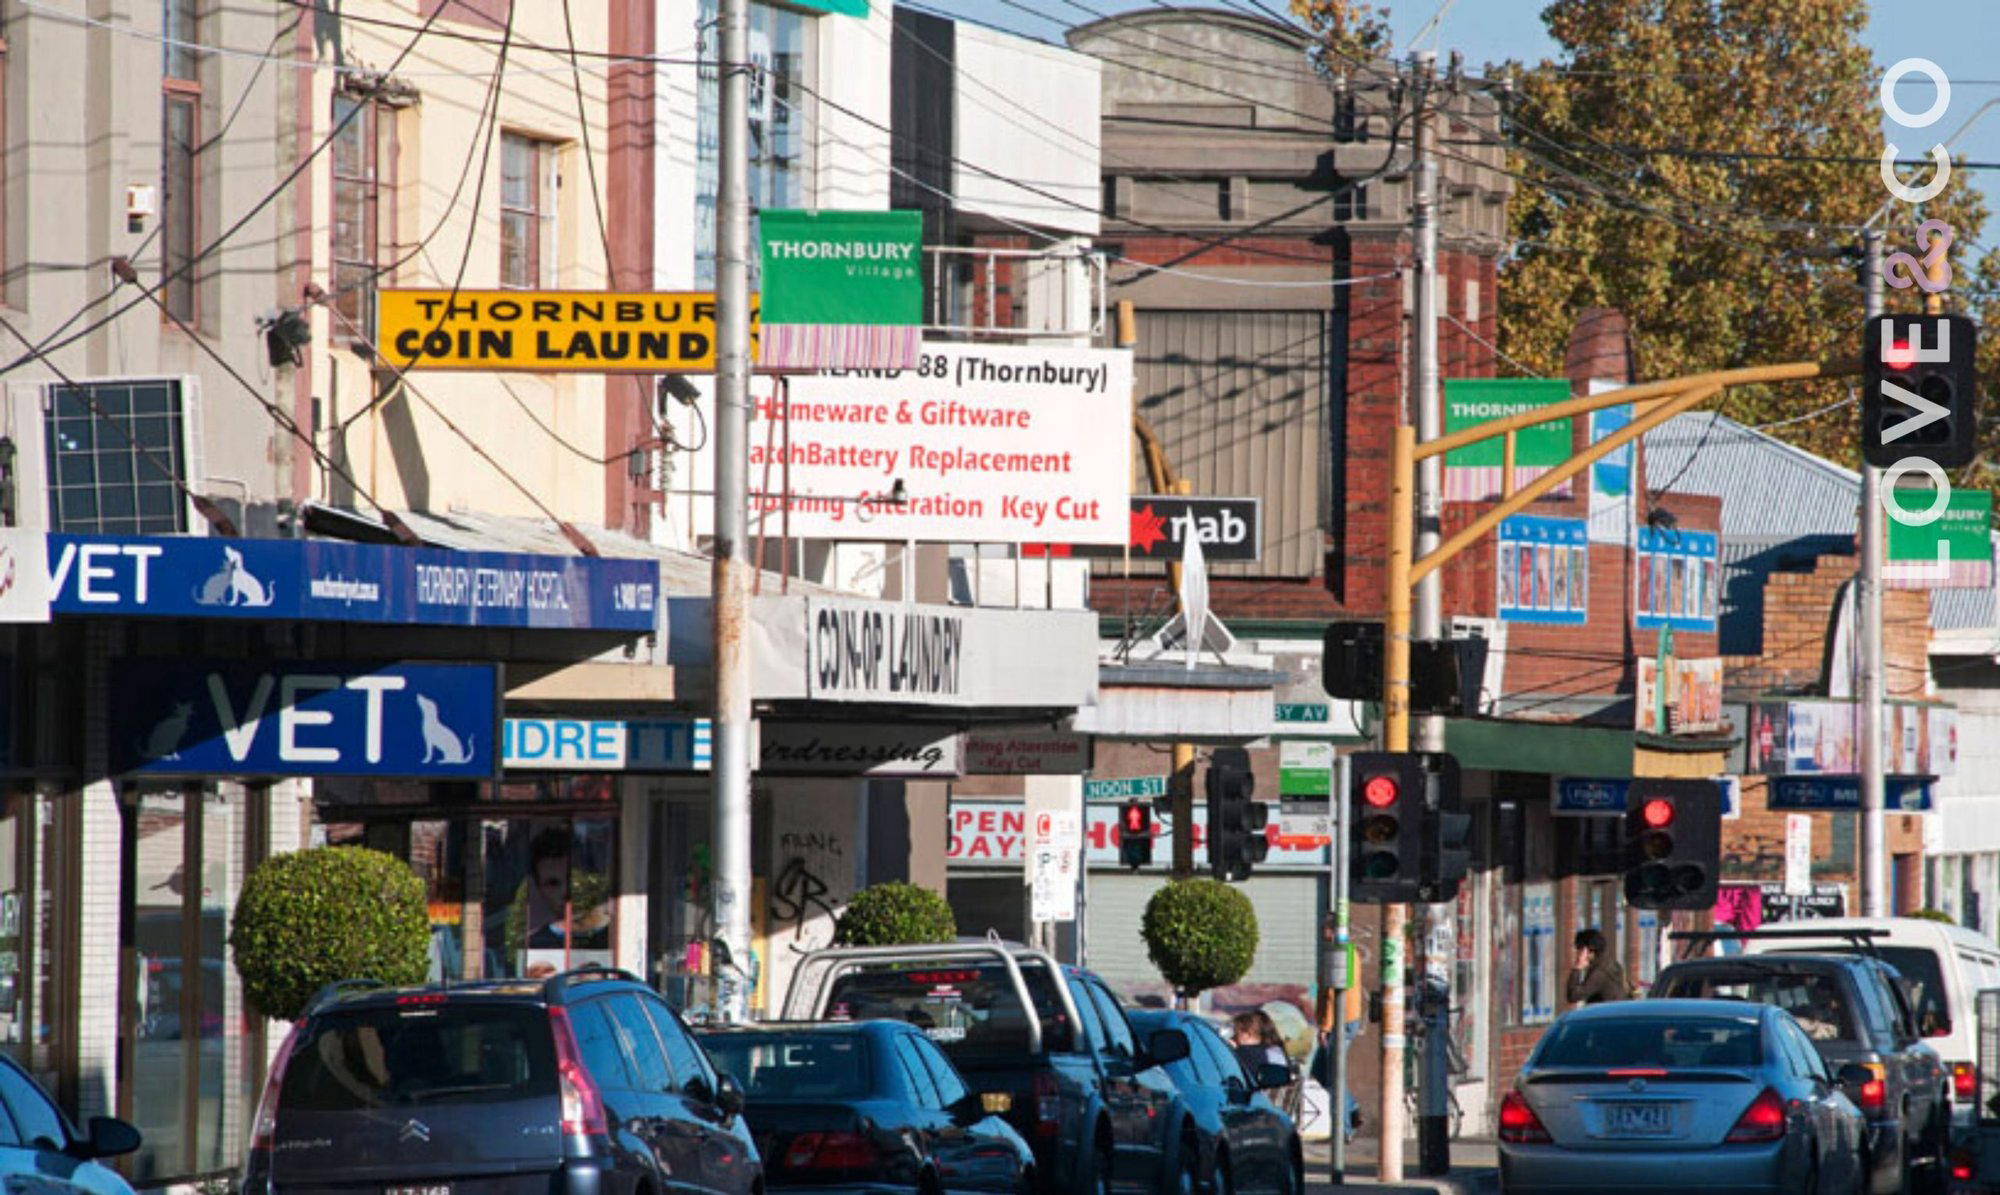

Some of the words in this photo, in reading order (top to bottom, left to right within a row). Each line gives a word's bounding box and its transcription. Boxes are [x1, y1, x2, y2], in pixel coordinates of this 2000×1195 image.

[767, 240, 914, 259] THORNBURY
[846, 264, 914, 280] Village
[416, 299, 759, 323] THORNBUR
[395, 329, 512, 359] COIN
[956, 357, 1108, 393] (Thornbury)
[754, 397, 887, 424] Homeware
[895, 400, 913, 424] &
[920, 402, 1031, 429] Giftware
[909, 445, 1072, 476] Replacement
[1002, 496, 1047, 527] Key
[1056, 498, 1100, 522] Cut
[1170, 508, 1247, 545] nab
[817, 608, 883, 691] COIN-OP
[889, 612, 962, 695] LAUNDRY
[206, 673, 406, 763] VET
[1303, 706, 1326, 721] AV
